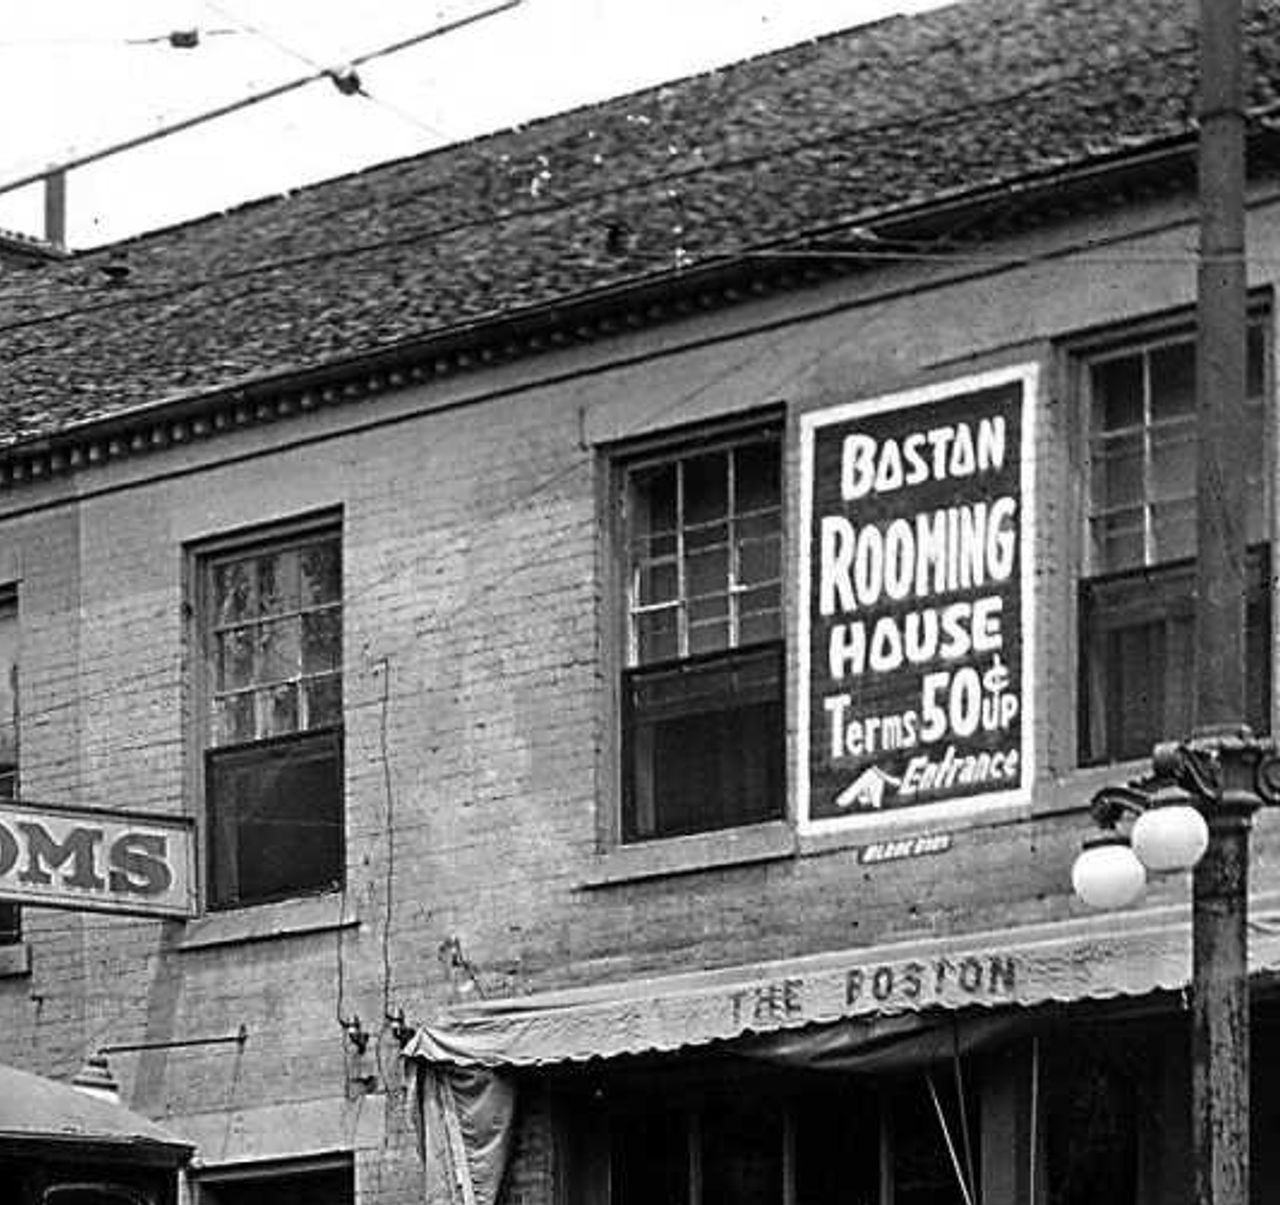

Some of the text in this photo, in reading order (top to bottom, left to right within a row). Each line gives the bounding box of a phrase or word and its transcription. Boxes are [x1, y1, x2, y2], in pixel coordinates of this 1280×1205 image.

[820, 497, 1016, 616] ROOMING
[829, 596, 1003, 679] HOUSE
[898, 745, 1018, 794] Entrance
[730, 979, 803, 1023] THE
